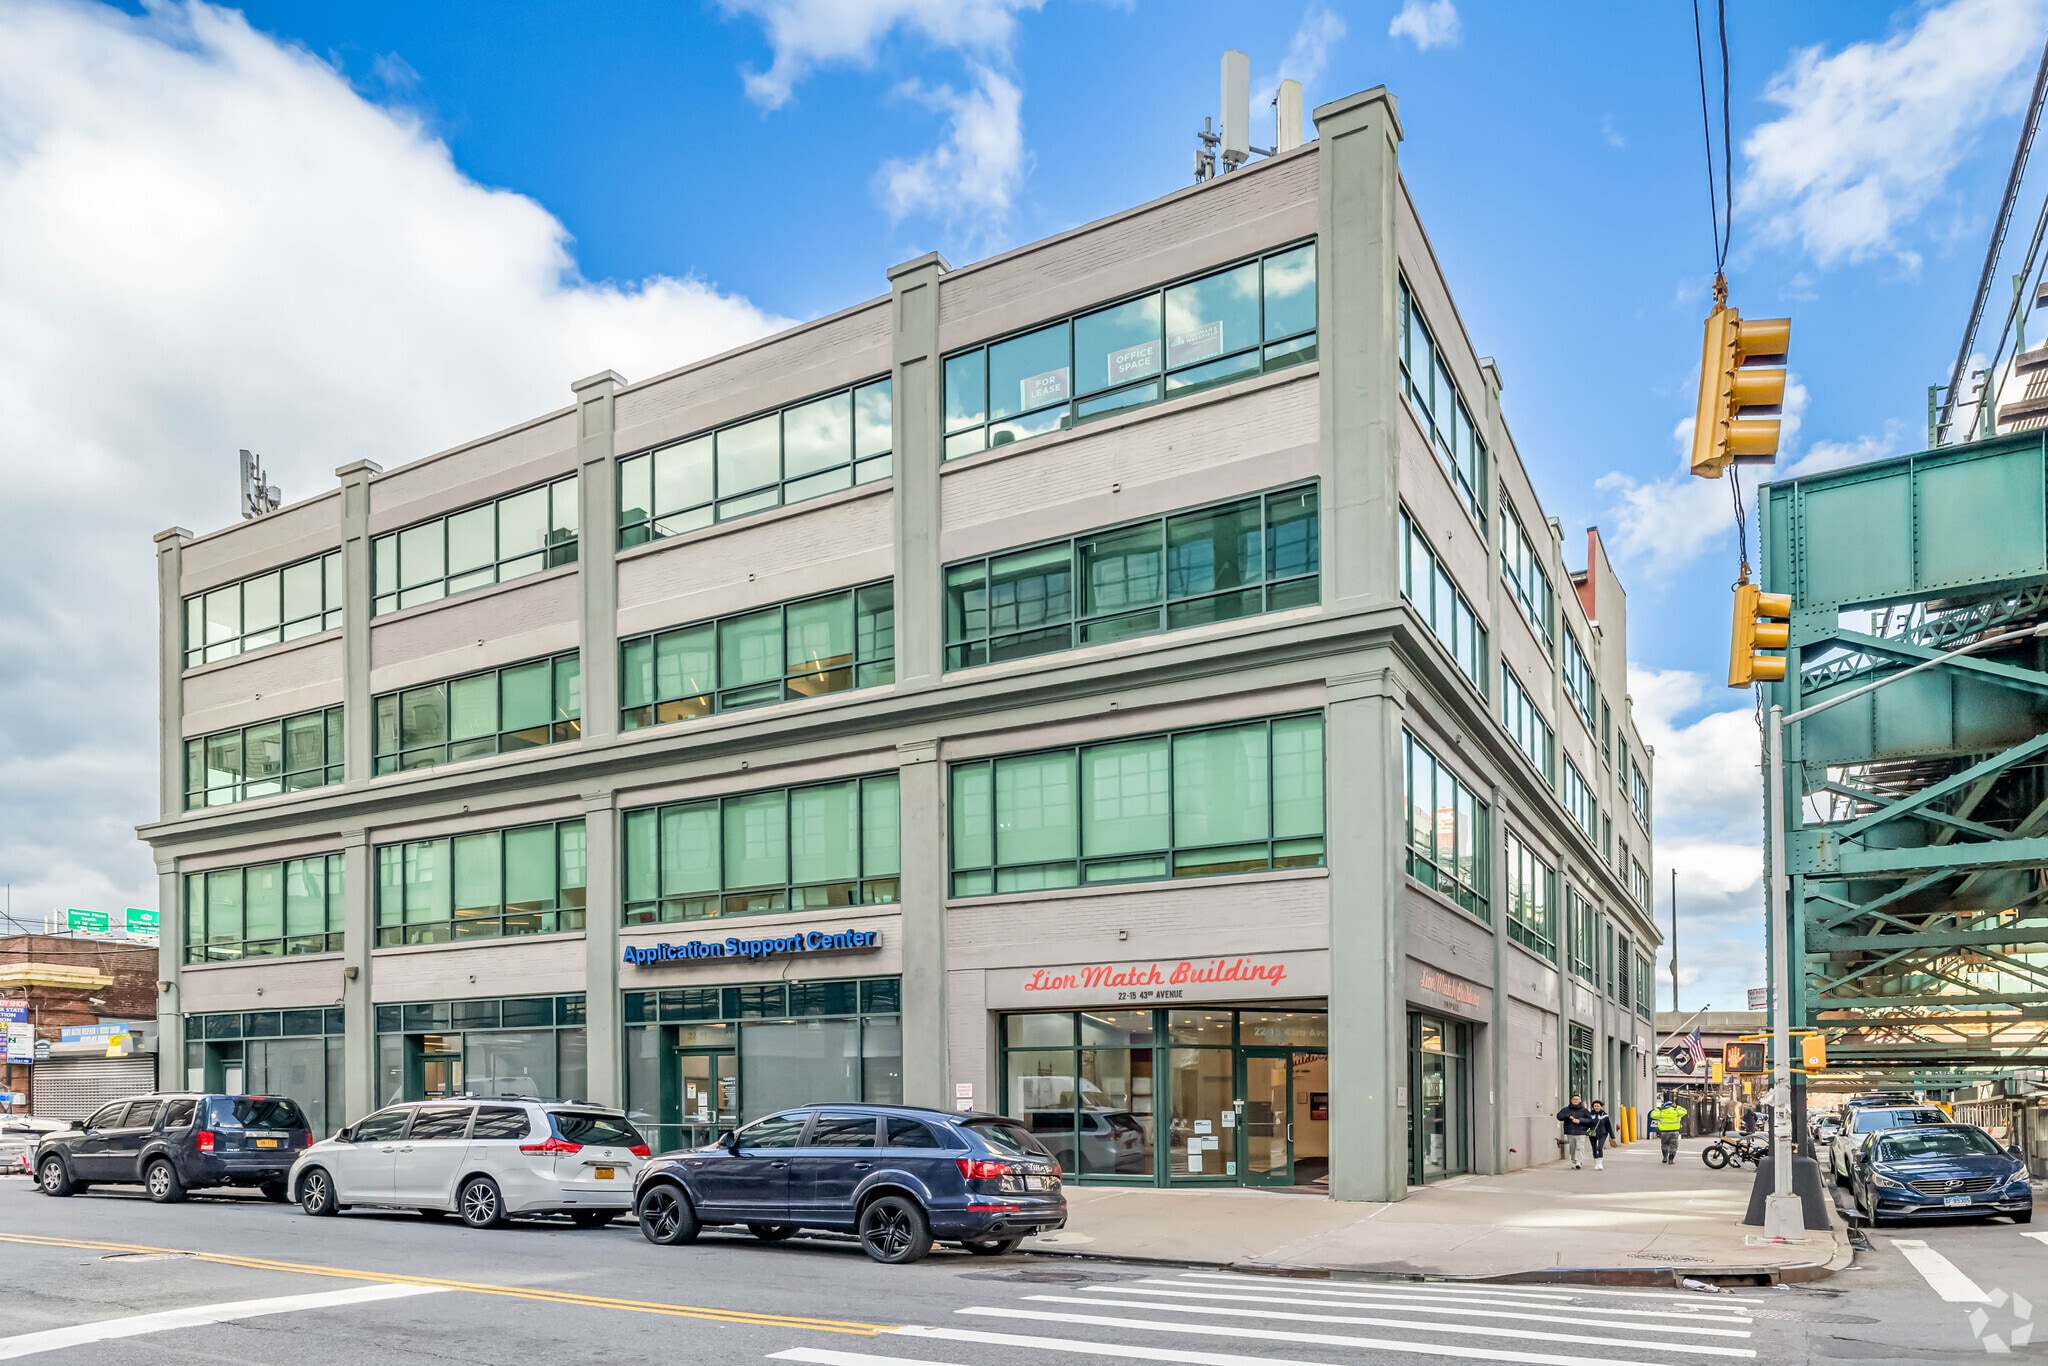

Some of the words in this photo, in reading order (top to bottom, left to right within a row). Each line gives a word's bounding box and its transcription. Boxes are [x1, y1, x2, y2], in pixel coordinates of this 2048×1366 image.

[1116, 347, 1153, 364] OFFICE
[1119, 357, 1152, 373] SPACE
[1036, 375, 1056, 389] FOR
[1031, 383, 1061, 398] LEASE
[623, 941, 722, 966] Application
[725, 934, 803, 958] Support
[807, 929, 873, 949] Center
[1024, 969, 1079, 991] Lion
[1080, 963, 1166, 988] Match
[1169, 958, 1287, 986] Building
[1118, 991, 1137, 1000] 22-15
[1156, 989, 1184, 999] AVENUE
[1309, 1028, 1327, 1038] Ave
